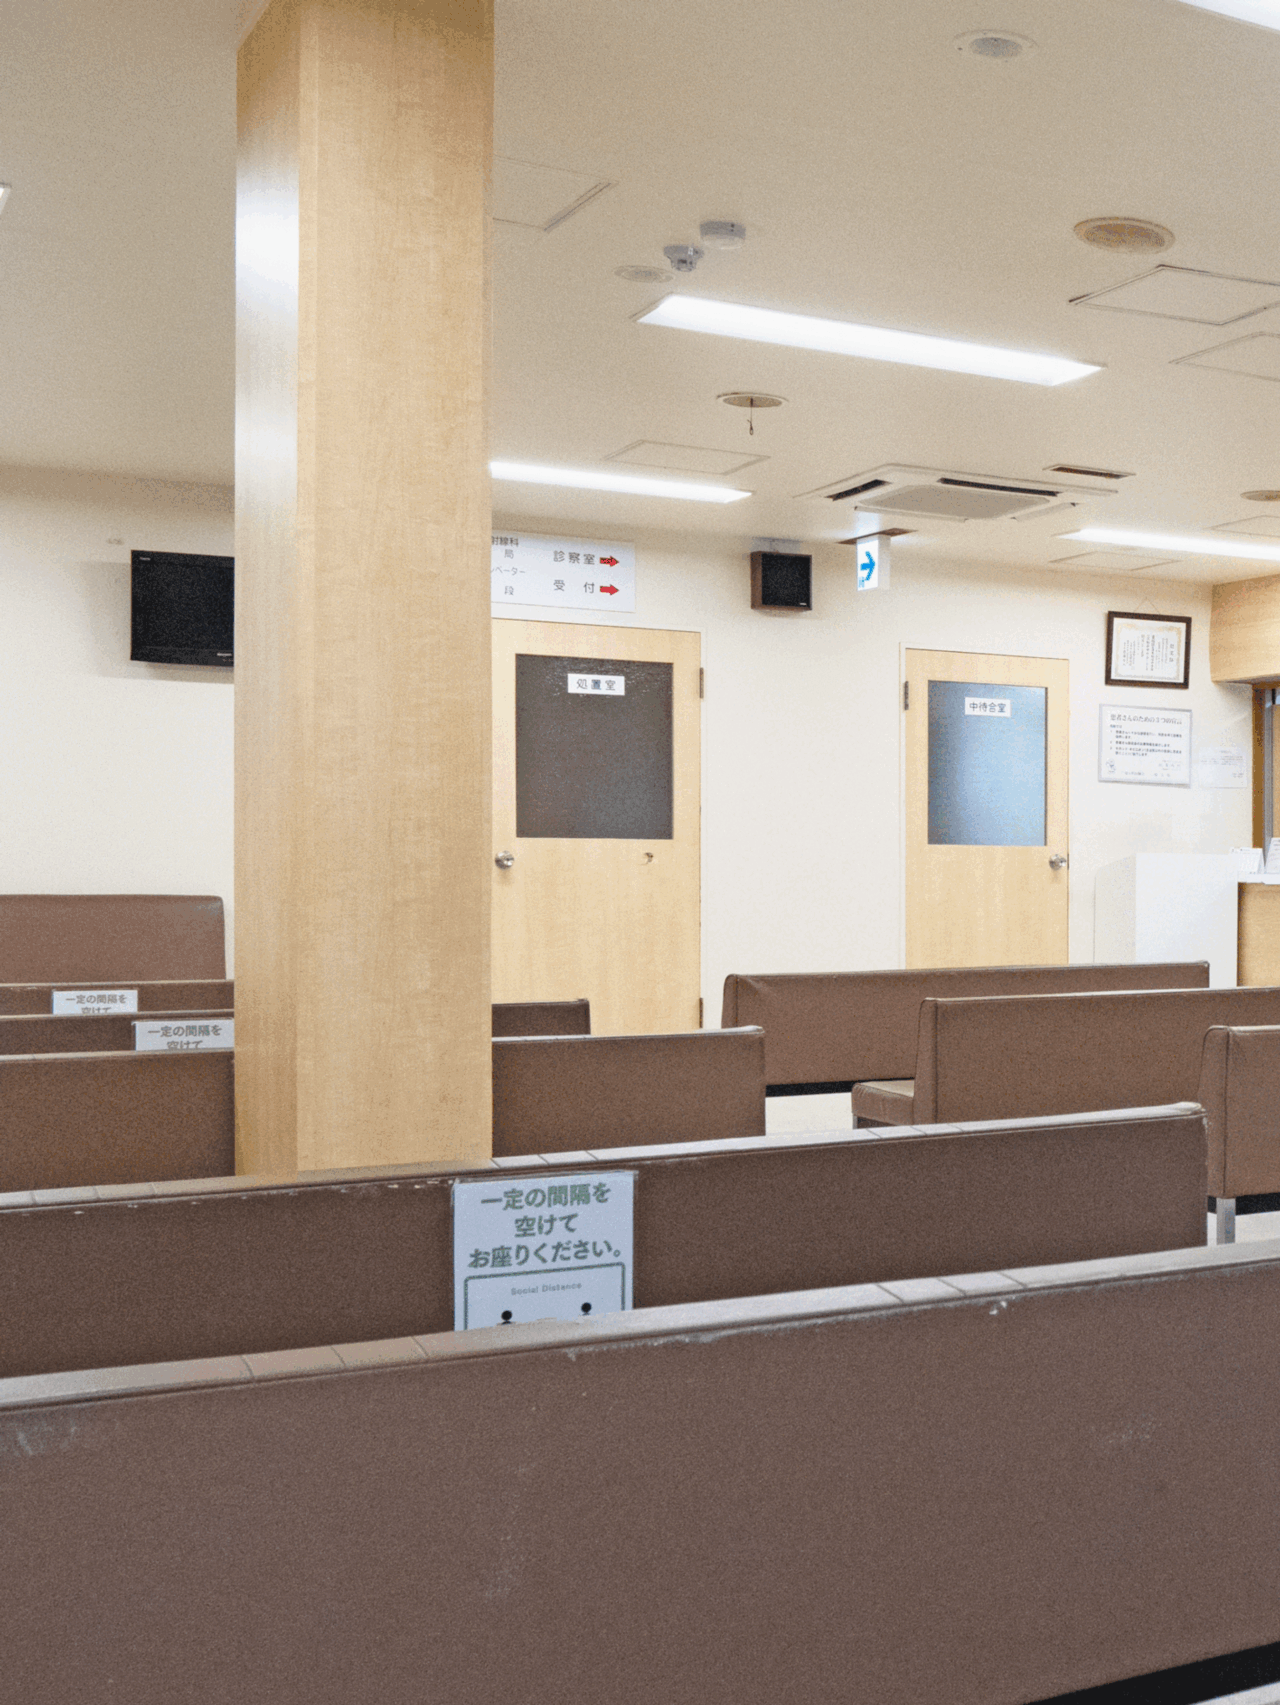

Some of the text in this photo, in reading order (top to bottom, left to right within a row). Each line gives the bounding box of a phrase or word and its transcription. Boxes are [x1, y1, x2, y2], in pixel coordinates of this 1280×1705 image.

[553, 550, 595, 565] 診察室
[504, 585, 515, 596] 段
[576, 678, 616, 691] 処置室
[969, 701, 1006, 713] 中待合室
[65, 994, 127, 1005] 一定の間隔を
[147, 1025, 223, 1037] 一定の間隔を
[480, 1182, 611, 1211] 一定の間隔を
[514, 1213, 578, 1238] 空けて
[468, 1239, 622, 1269] お座りください。
[510, 1282, 583, 1296] Social Distance
